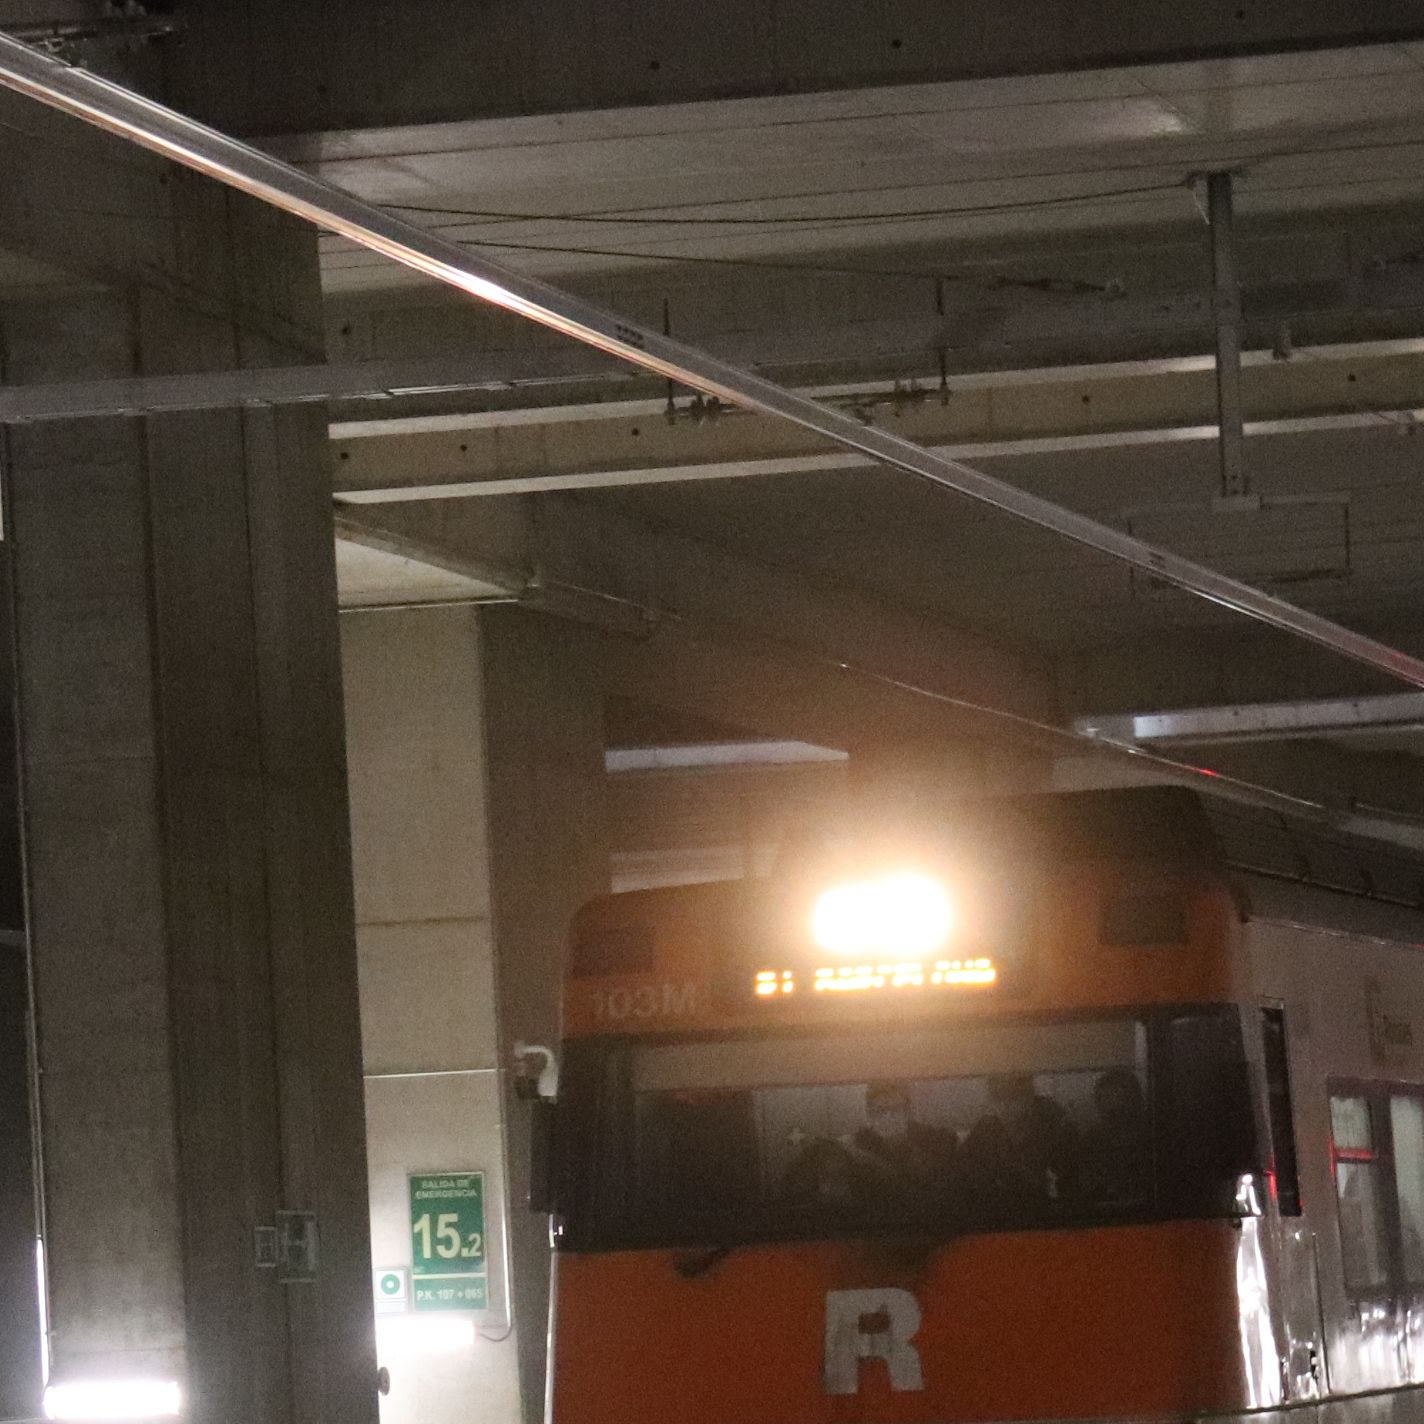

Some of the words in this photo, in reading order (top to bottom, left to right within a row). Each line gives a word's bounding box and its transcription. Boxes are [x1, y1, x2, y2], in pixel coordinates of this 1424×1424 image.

[415, 1189, 477, 1200] EMERGENCIA
[421, 1180, 454, 1189] SALIDA
[456, 1179, 469, 1188] DE
[413, 1212, 482, 1259] 15.2
[824, 1286, 925, 1395] R
